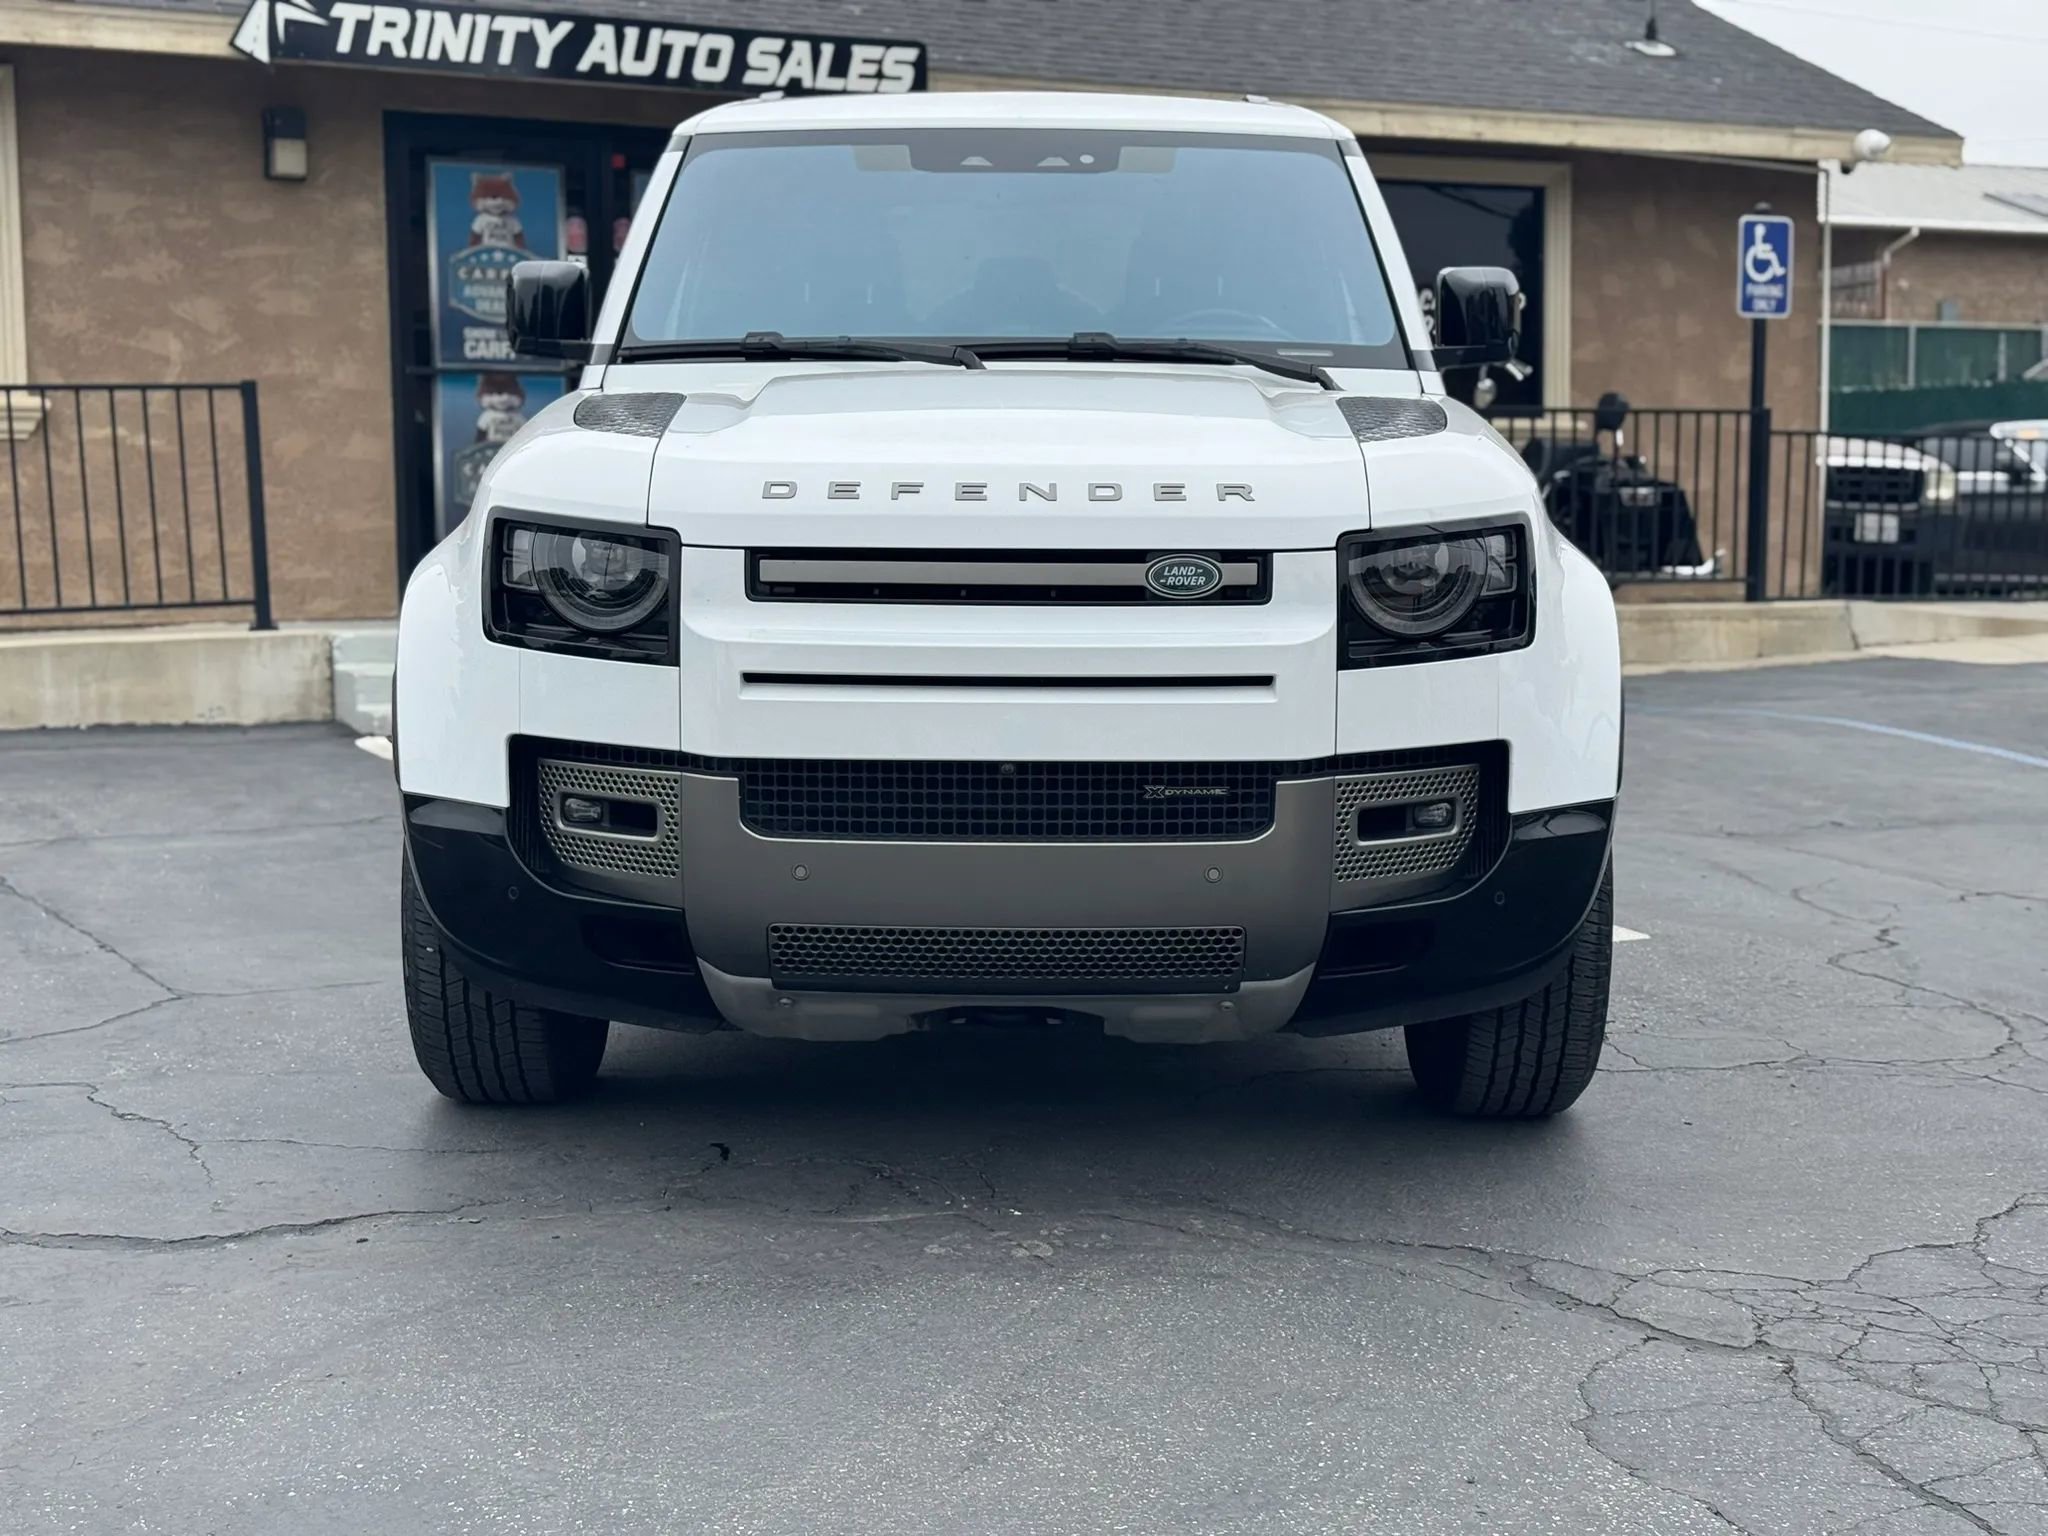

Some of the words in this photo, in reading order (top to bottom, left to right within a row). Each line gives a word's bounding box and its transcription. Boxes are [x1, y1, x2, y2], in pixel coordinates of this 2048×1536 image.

[329, 2, 575, 69] TRINITY
[576, 24, 734, 83] AUTO
[742, 37, 920, 93] SALES
[762, 480, 1256, 501] DEFENDER
